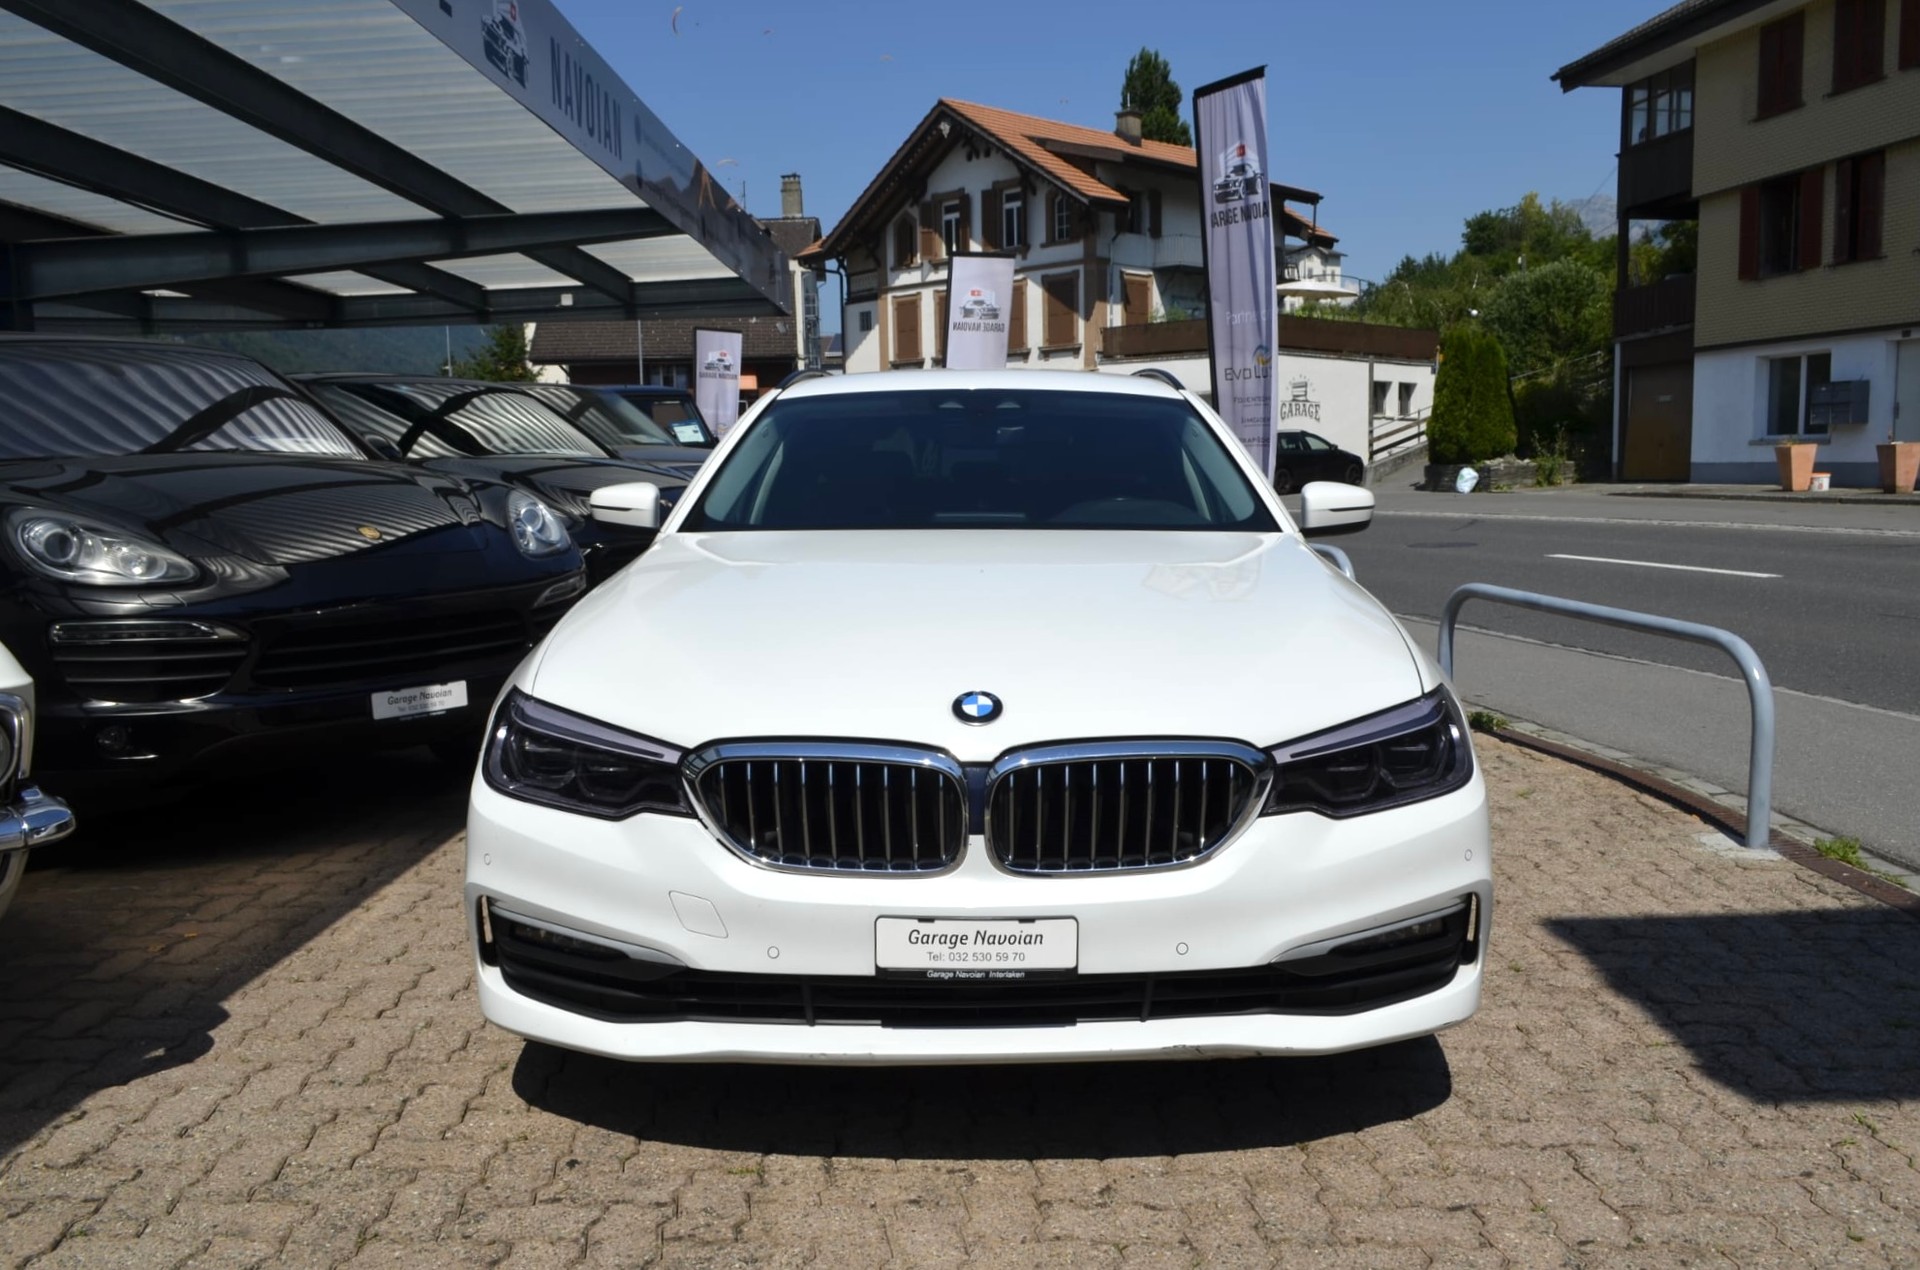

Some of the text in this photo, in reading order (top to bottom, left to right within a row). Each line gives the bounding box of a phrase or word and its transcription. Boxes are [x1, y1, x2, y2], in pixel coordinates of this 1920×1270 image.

[550, 35, 622, 161] NAVOIAN
[1280, 402, 1321, 422] GARAGE
[387, 694, 418, 706] Garage
[908, 929, 1044, 949] Garage Navoian
[926, 951, 1026, 962] Tel: 032 530 59 70
[927, 969, 1025, 980] Garage Navoian Interlaken
